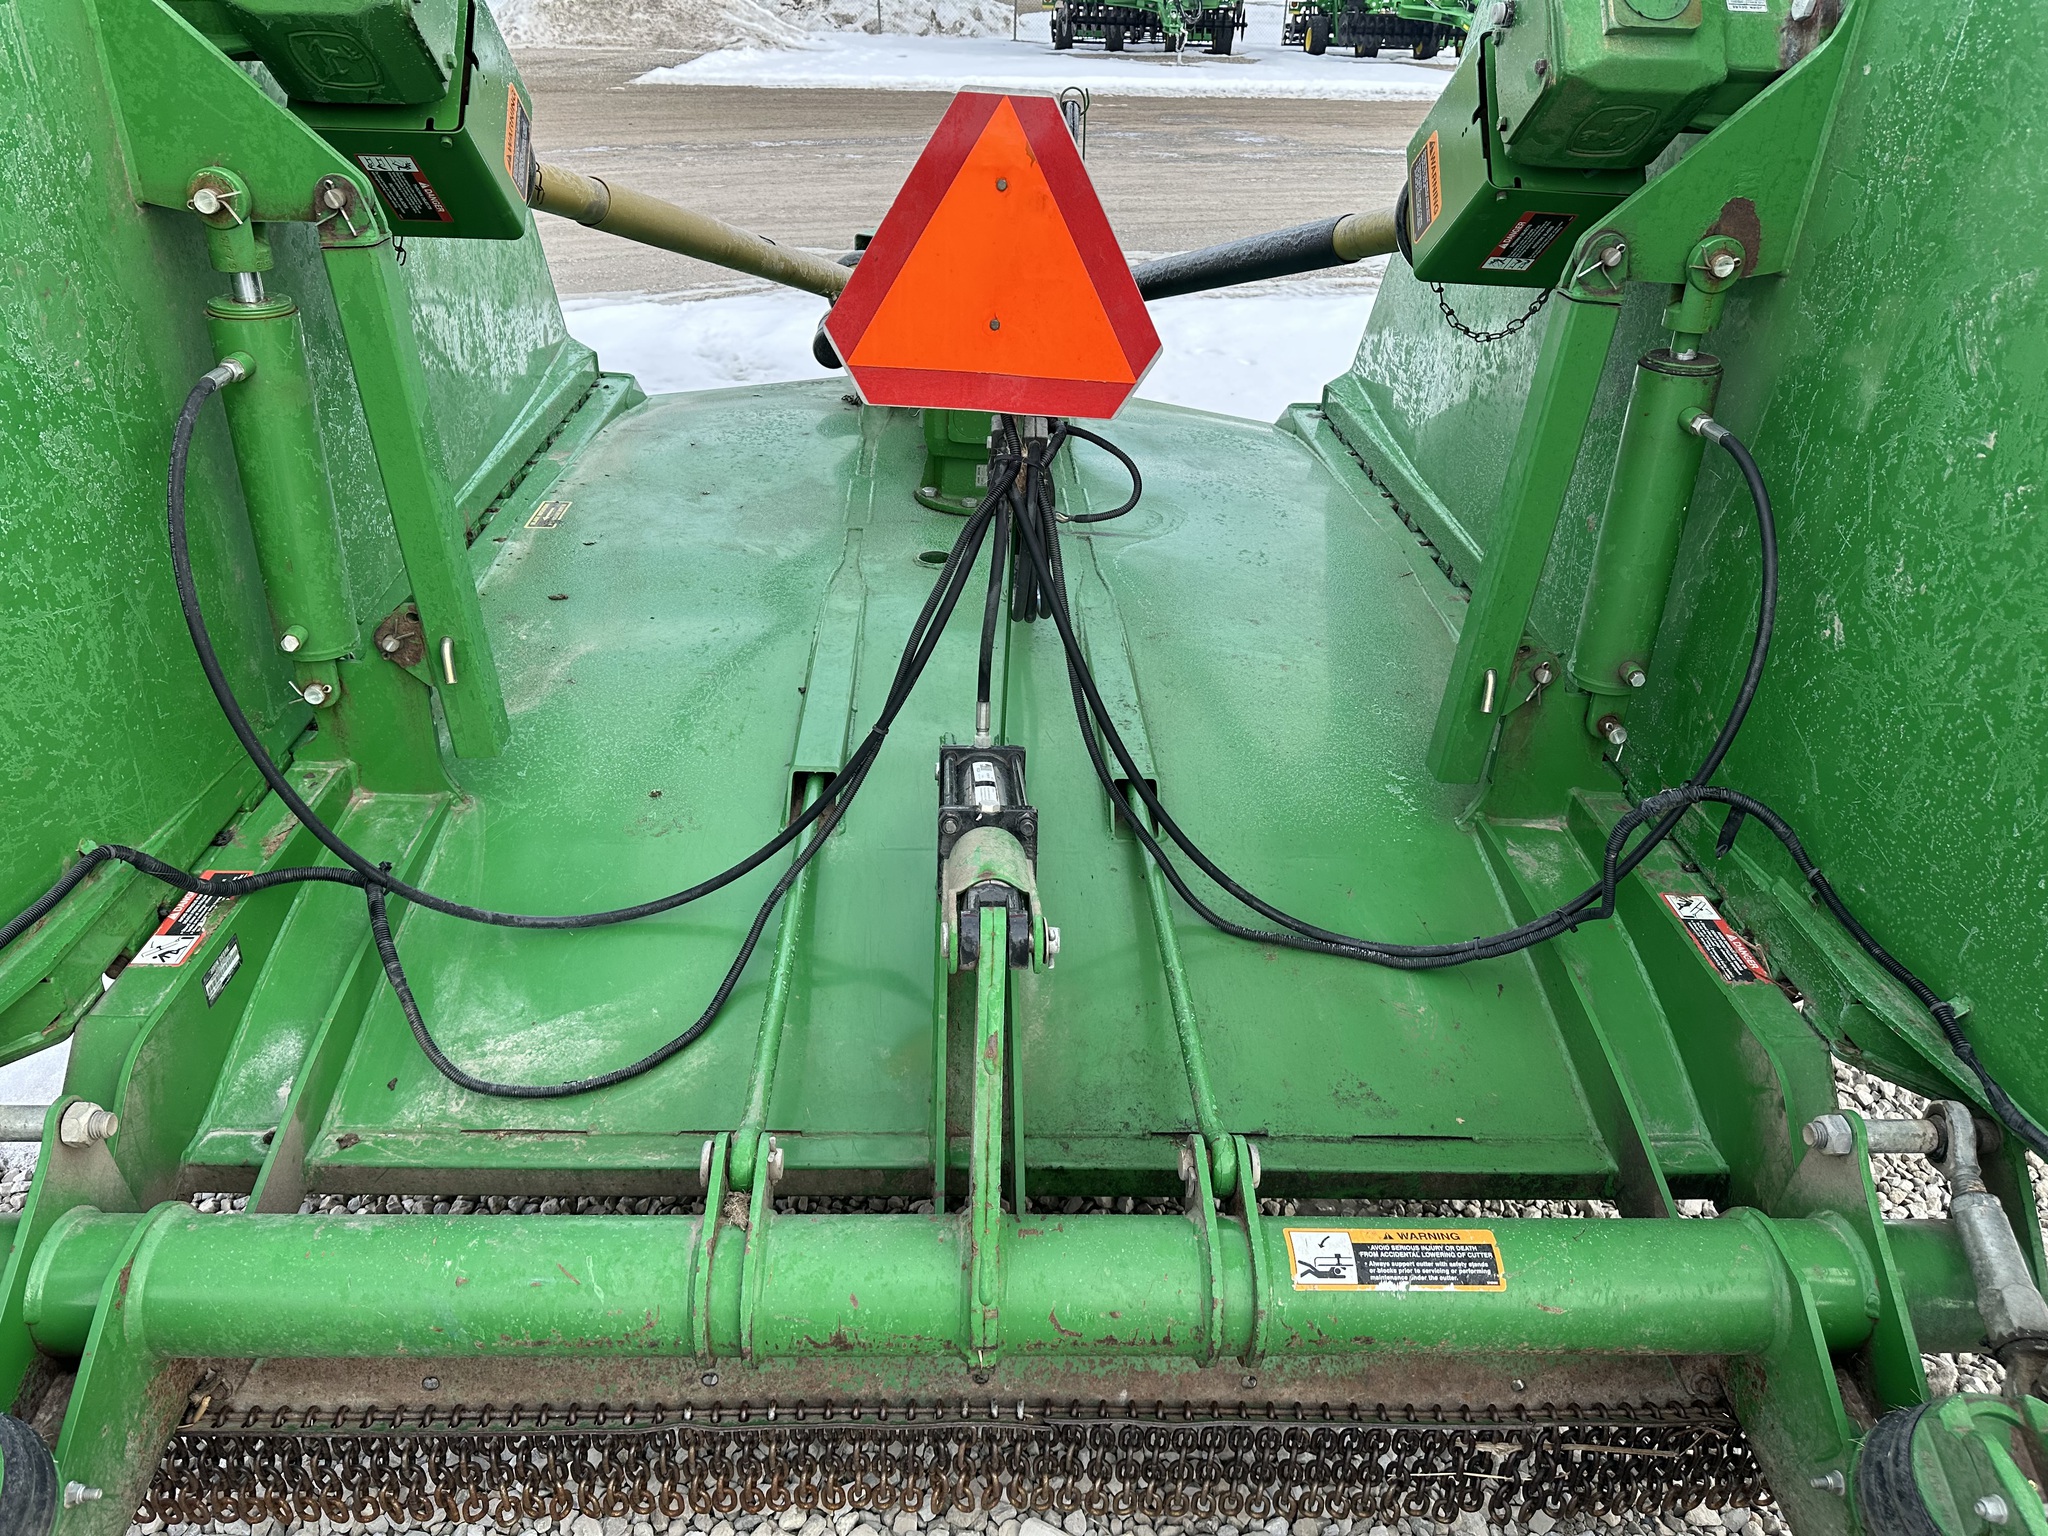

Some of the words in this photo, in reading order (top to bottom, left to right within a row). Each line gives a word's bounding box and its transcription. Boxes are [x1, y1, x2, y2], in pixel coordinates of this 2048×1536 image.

[1430, 153, 1439, 215] WARNING
[425, 188, 445, 213] DANGER
[1504, 221, 1527, 244] DANGER
[1733, 941, 1759, 969] DANGER
[1397, 1232, 1461, 1241] WARNING
